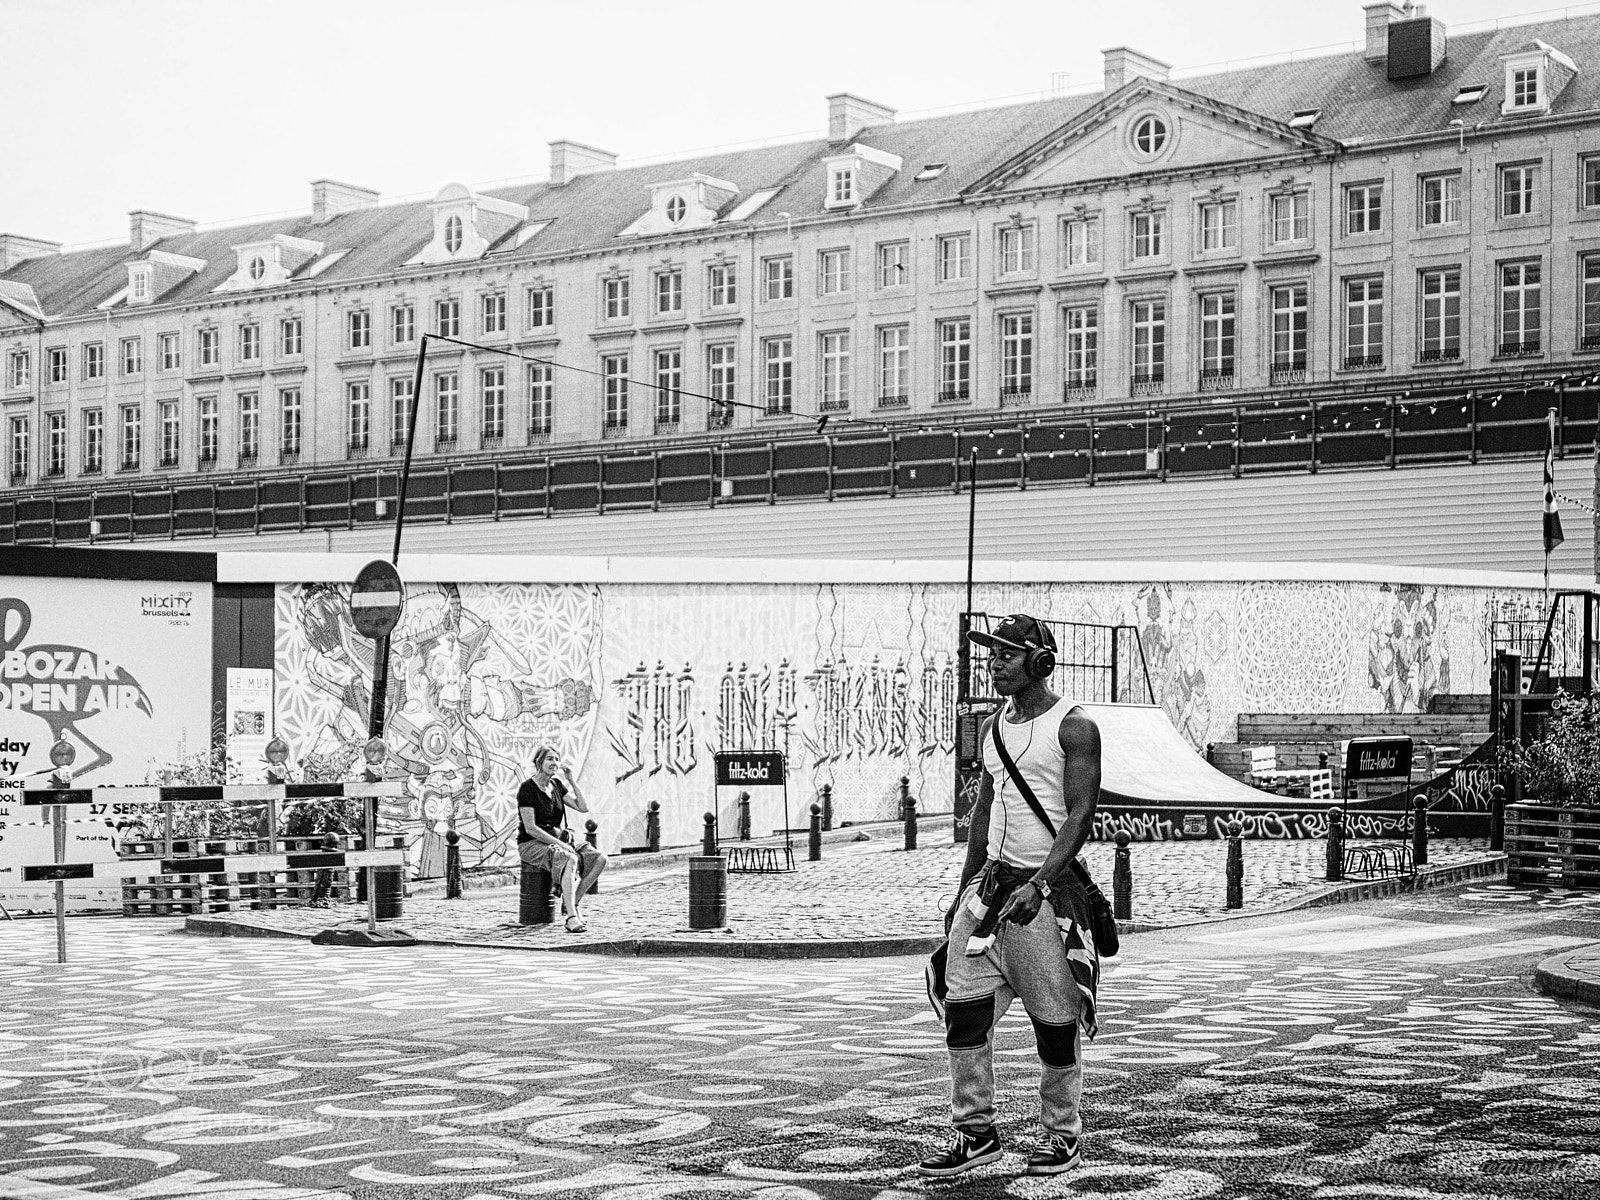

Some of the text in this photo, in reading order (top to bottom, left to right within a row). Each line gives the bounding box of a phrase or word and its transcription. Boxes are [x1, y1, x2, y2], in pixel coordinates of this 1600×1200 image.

[5, 651, 119, 680] BOZAR
[230, 677, 269, 689] LE MUR
[82, 684, 142, 712] AIR
[728, 761, 768, 779] fritz-kola
[90, 803, 107, 815] 17
